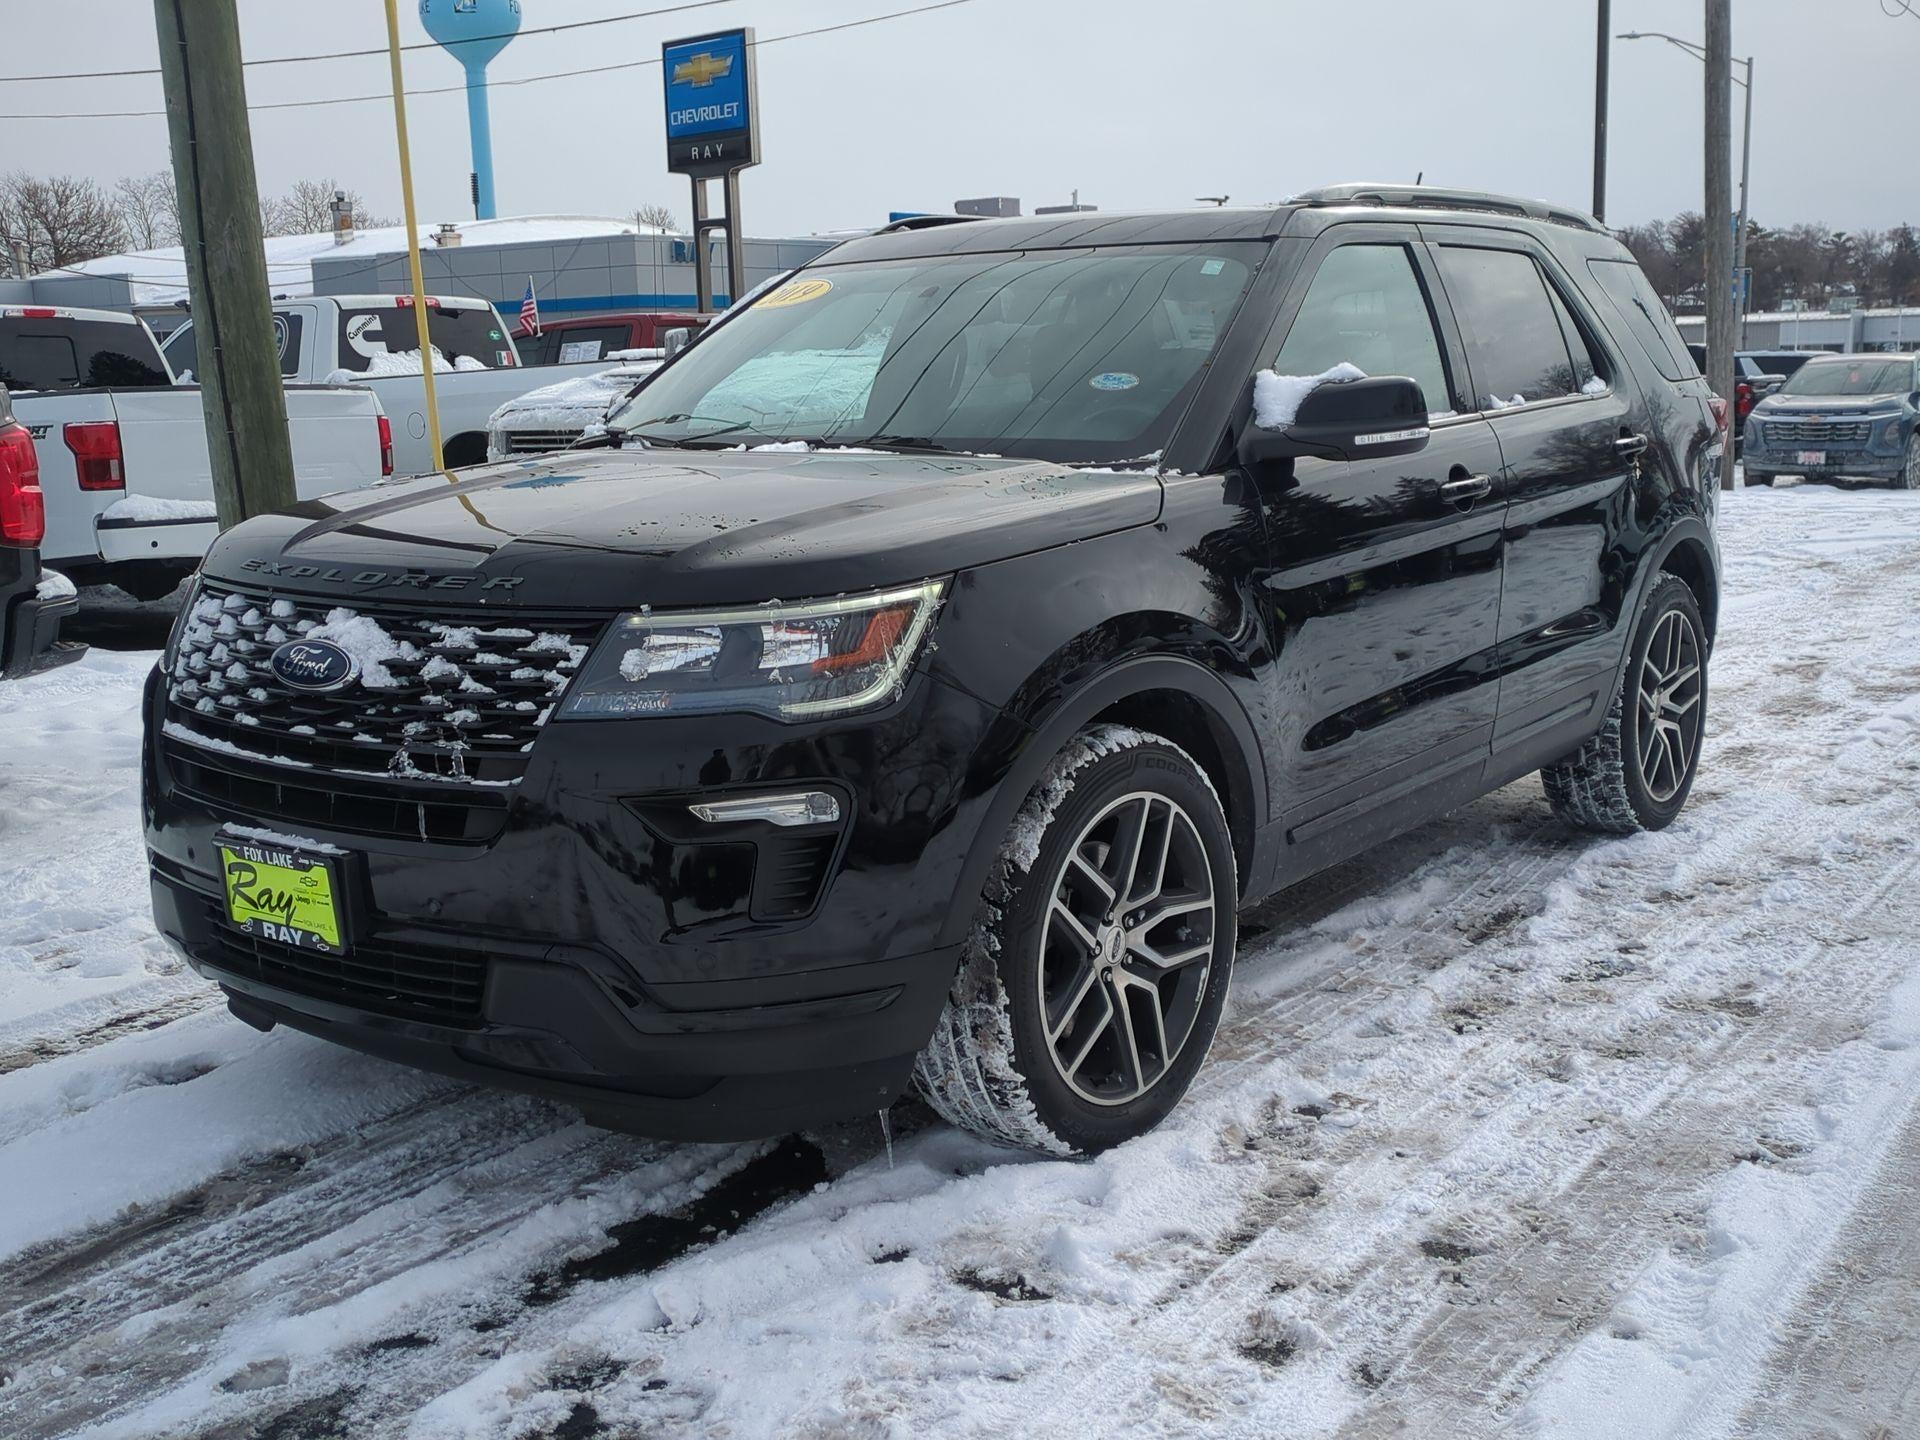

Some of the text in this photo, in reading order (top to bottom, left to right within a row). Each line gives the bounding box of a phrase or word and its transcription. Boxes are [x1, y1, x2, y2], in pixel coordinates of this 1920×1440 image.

[671, 102, 739, 126] CHEVROLET
[691, 143, 723, 160] RAY
[347, 314, 378, 340] Cummins
[239, 558, 524, 590] EXPLORER
[283, 645, 331, 678] Ford
[243, 846, 264, 863] FOX
[266, 850, 294, 869] LAKE
[228, 861, 297, 927] Ray
[262, 922, 303, 946] RAY
